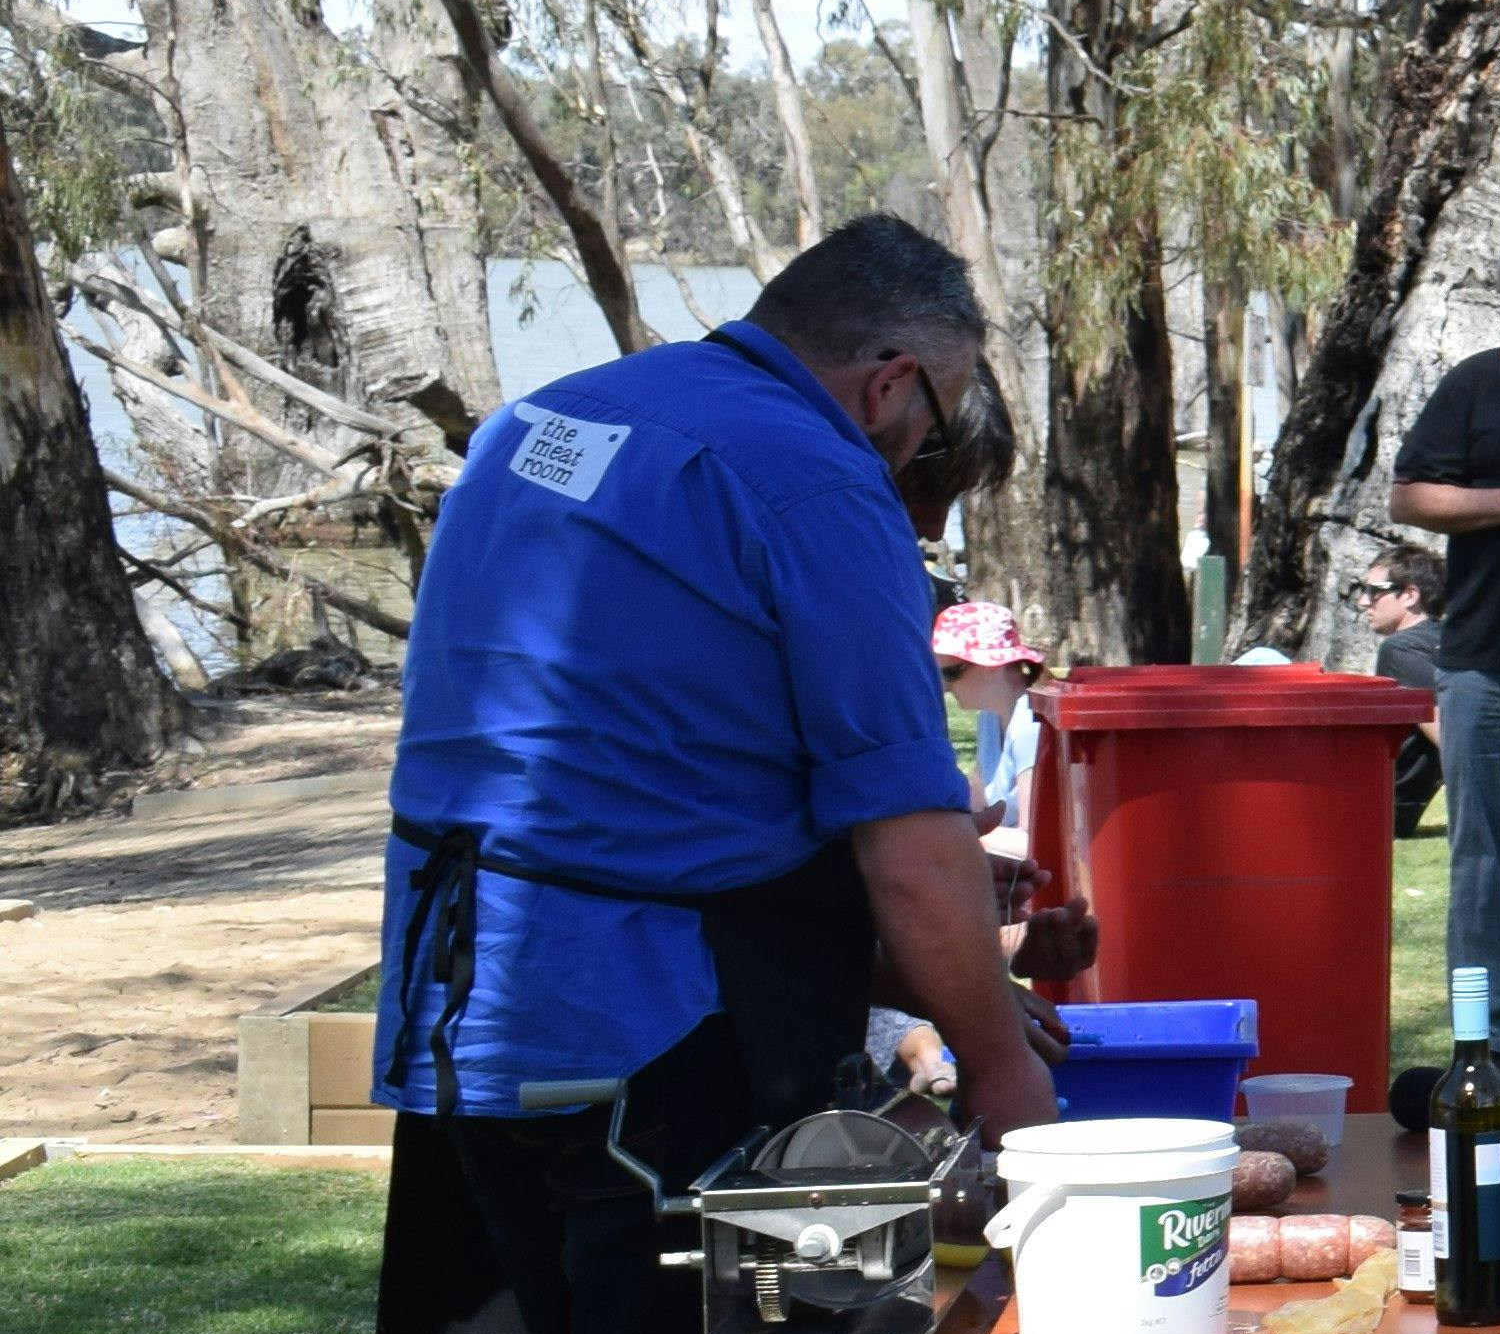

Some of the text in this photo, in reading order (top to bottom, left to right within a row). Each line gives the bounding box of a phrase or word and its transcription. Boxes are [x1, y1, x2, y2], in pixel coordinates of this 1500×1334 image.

[543, 416, 578, 443] the
[530, 438, 584, 467] meat
[519, 457, 573, 486] room
